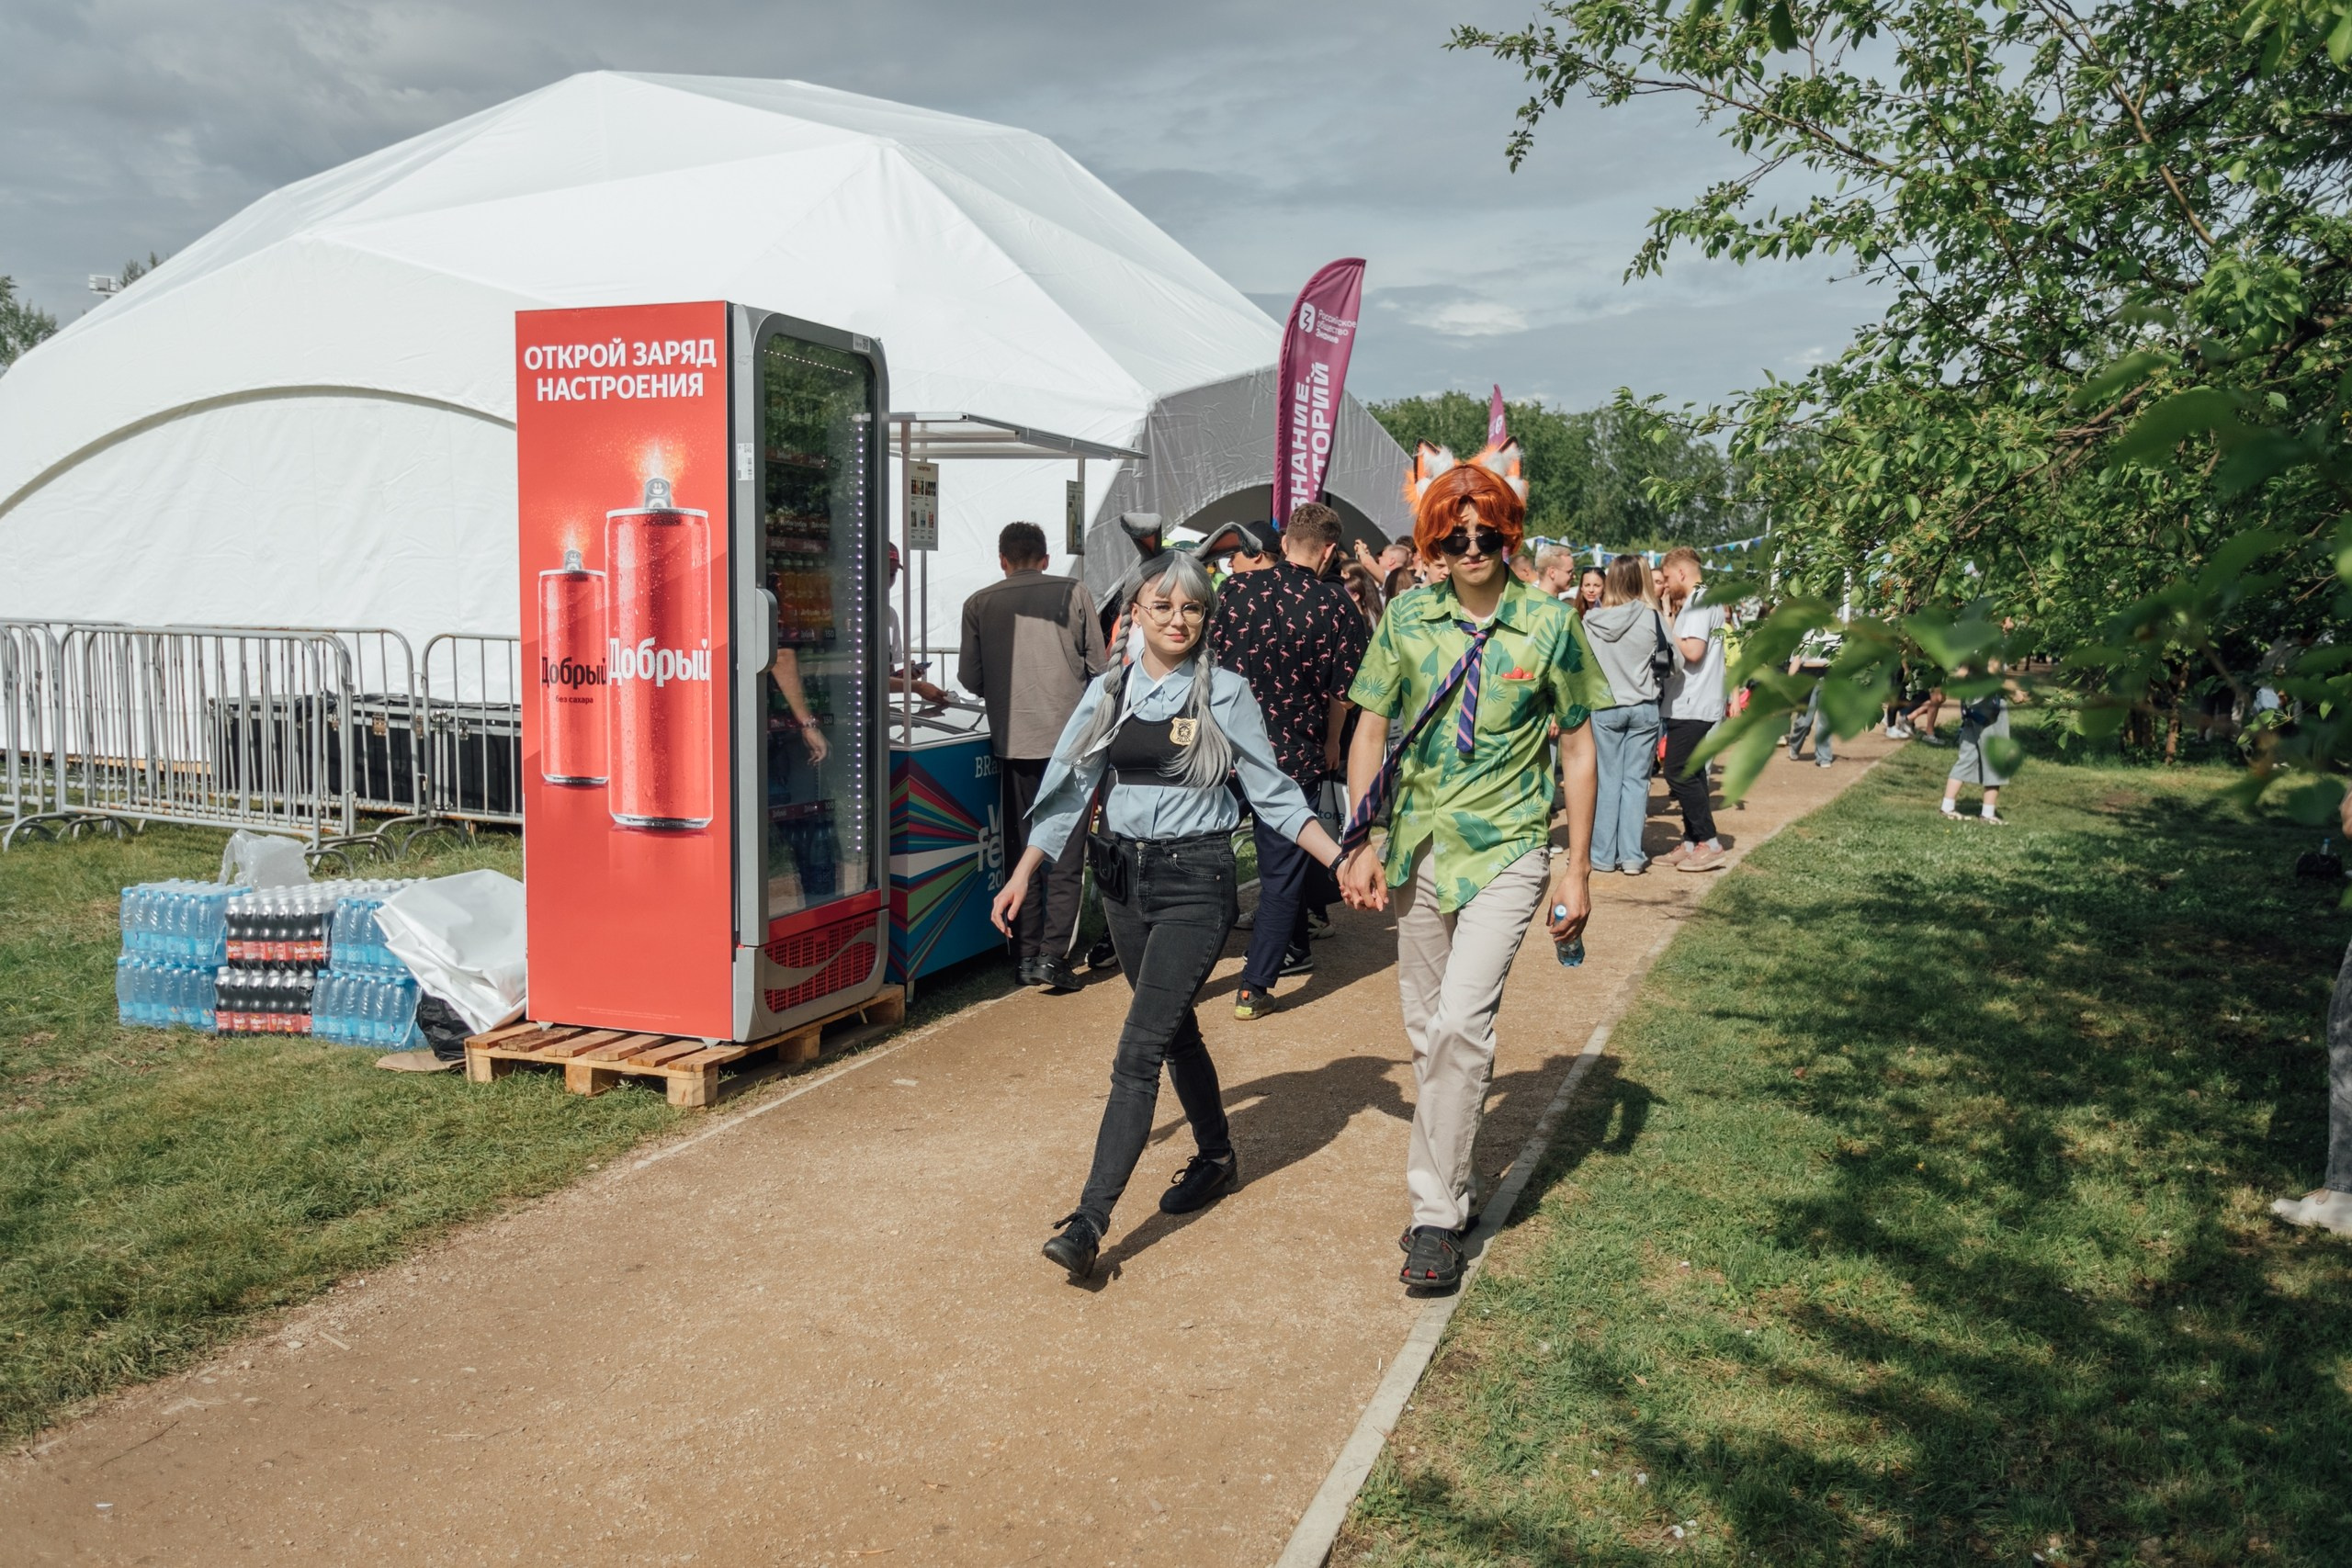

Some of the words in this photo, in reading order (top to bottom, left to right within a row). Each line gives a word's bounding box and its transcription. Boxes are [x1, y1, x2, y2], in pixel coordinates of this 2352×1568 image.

[524, 337, 627, 370] ОТКРОЙ
[632, 338, 718, 368] ЗАРЯД
[537, 372, 704, 402] НАСТРОЕНИЯ
[541, 656, 607, 690] Добрый
[609, 636, 711, 687] Добрый
[555, 694, 568, 704] без
[569, 696, 594, 705] сахара
